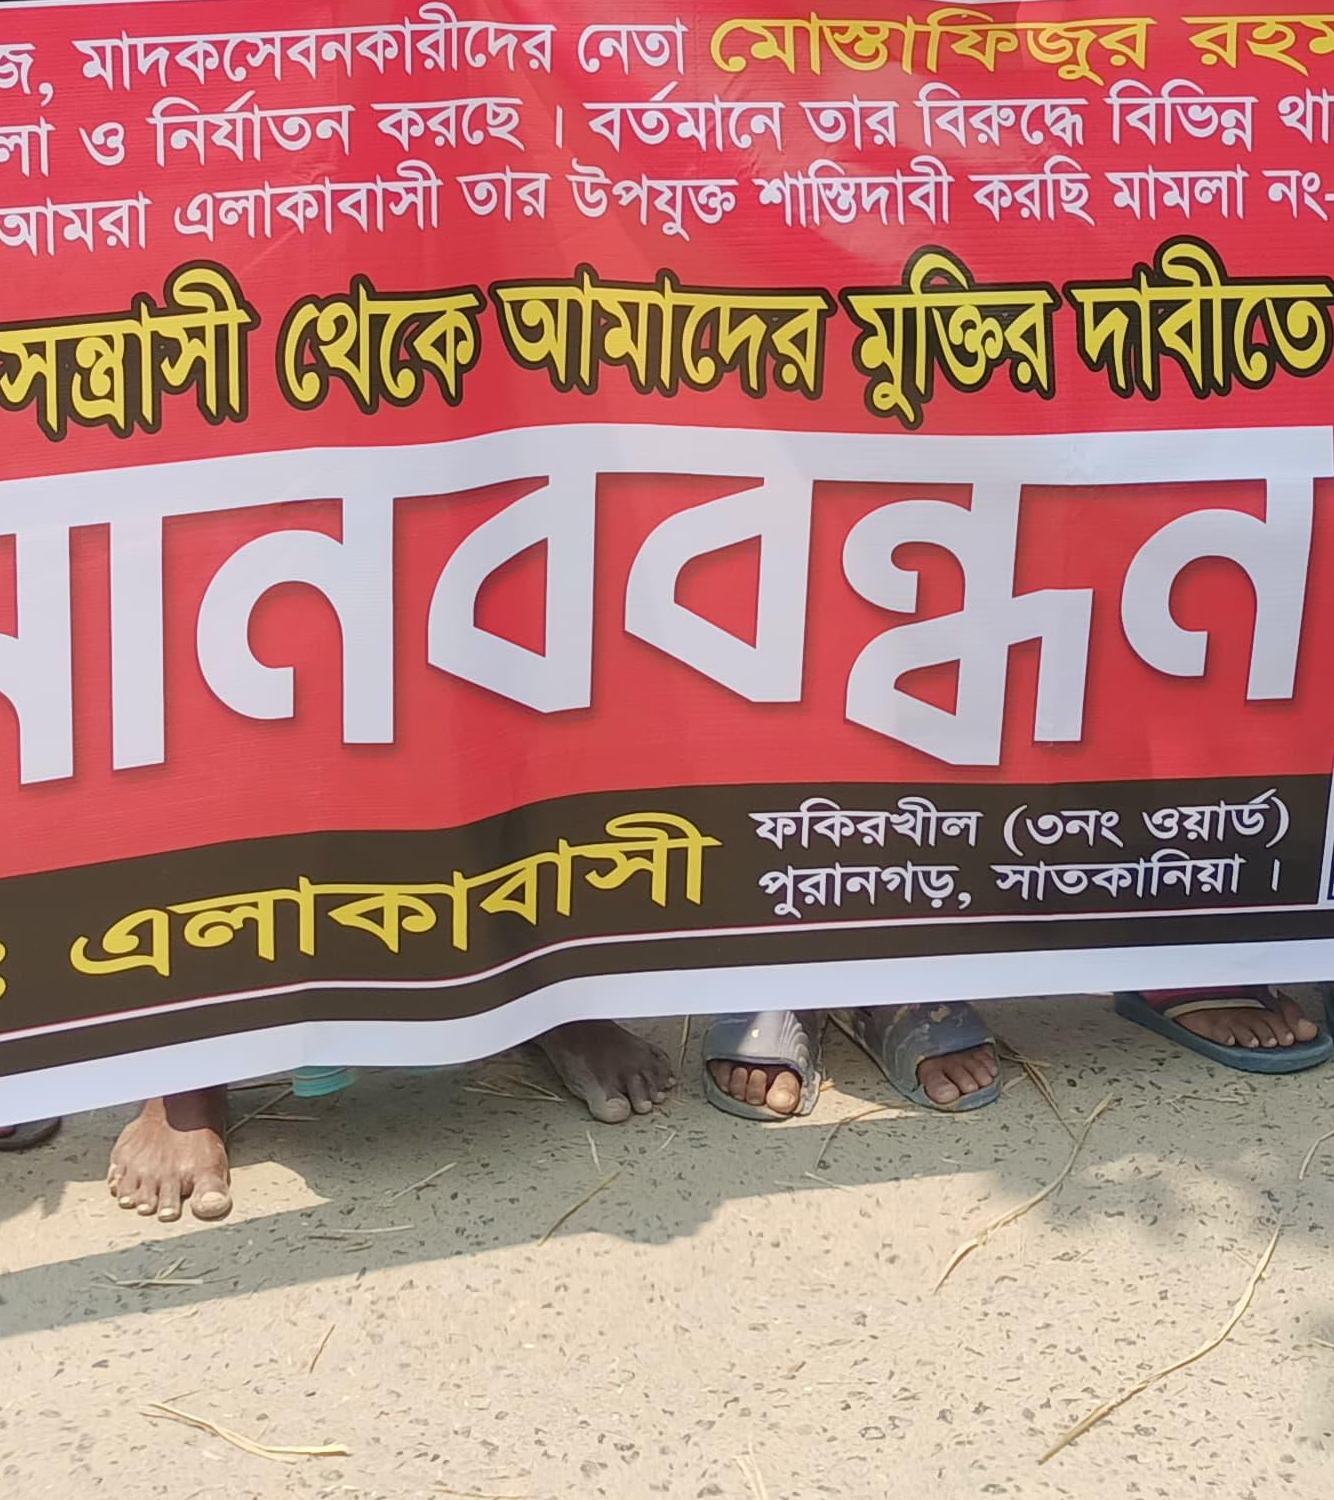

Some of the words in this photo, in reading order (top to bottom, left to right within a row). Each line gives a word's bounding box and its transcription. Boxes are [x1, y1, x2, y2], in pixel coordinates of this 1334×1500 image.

[73, 2, 556, 92] মাদকসেবনকারীদের
[578, 18, 689, 77] নেতা
[711, 6, 1158, 86] মোস্তাফিজুর
[81, 121, 126, 168] ও
[147, 89, 356, 168] নির্যাতন
[371, 96, 525, 152] করছে
[583, 82, 786, 152] বর্তমানে
[799, 94, 899, 151] তার
[915, 79, 1087, 148] বিরুদ্ধে
[1105, 78, 1258, 151] বিভিন্ন
[175, 160, 442, 242] এলাকাবাসী
[458, 166, 551, 222] তার
[568, 158, 737, 241] উপযুক্ত
[755, 154, 956, 229] শাস্তিদাবী
[969, 156, 1098, 226] করছি
[1105, 165, 1249, 221] মামলা
[280, 281, 488, 404] থেকে
[499, 264, 830, 395] আমাদের
[852, 252, 1060, 429] মুক্তির
[751, 797, 981, 855] ফকিরখীল
[1000, 804, 1124, 855] (৩নং
[1142, 789, 1290, 850] ওয়ার্ড)
[69, 811, 726, 982] এলাকাবাসী
[755, 853, 974, 920] পুরানগড়,
[993, 850, 1247, 905] সাতকানিয়া
